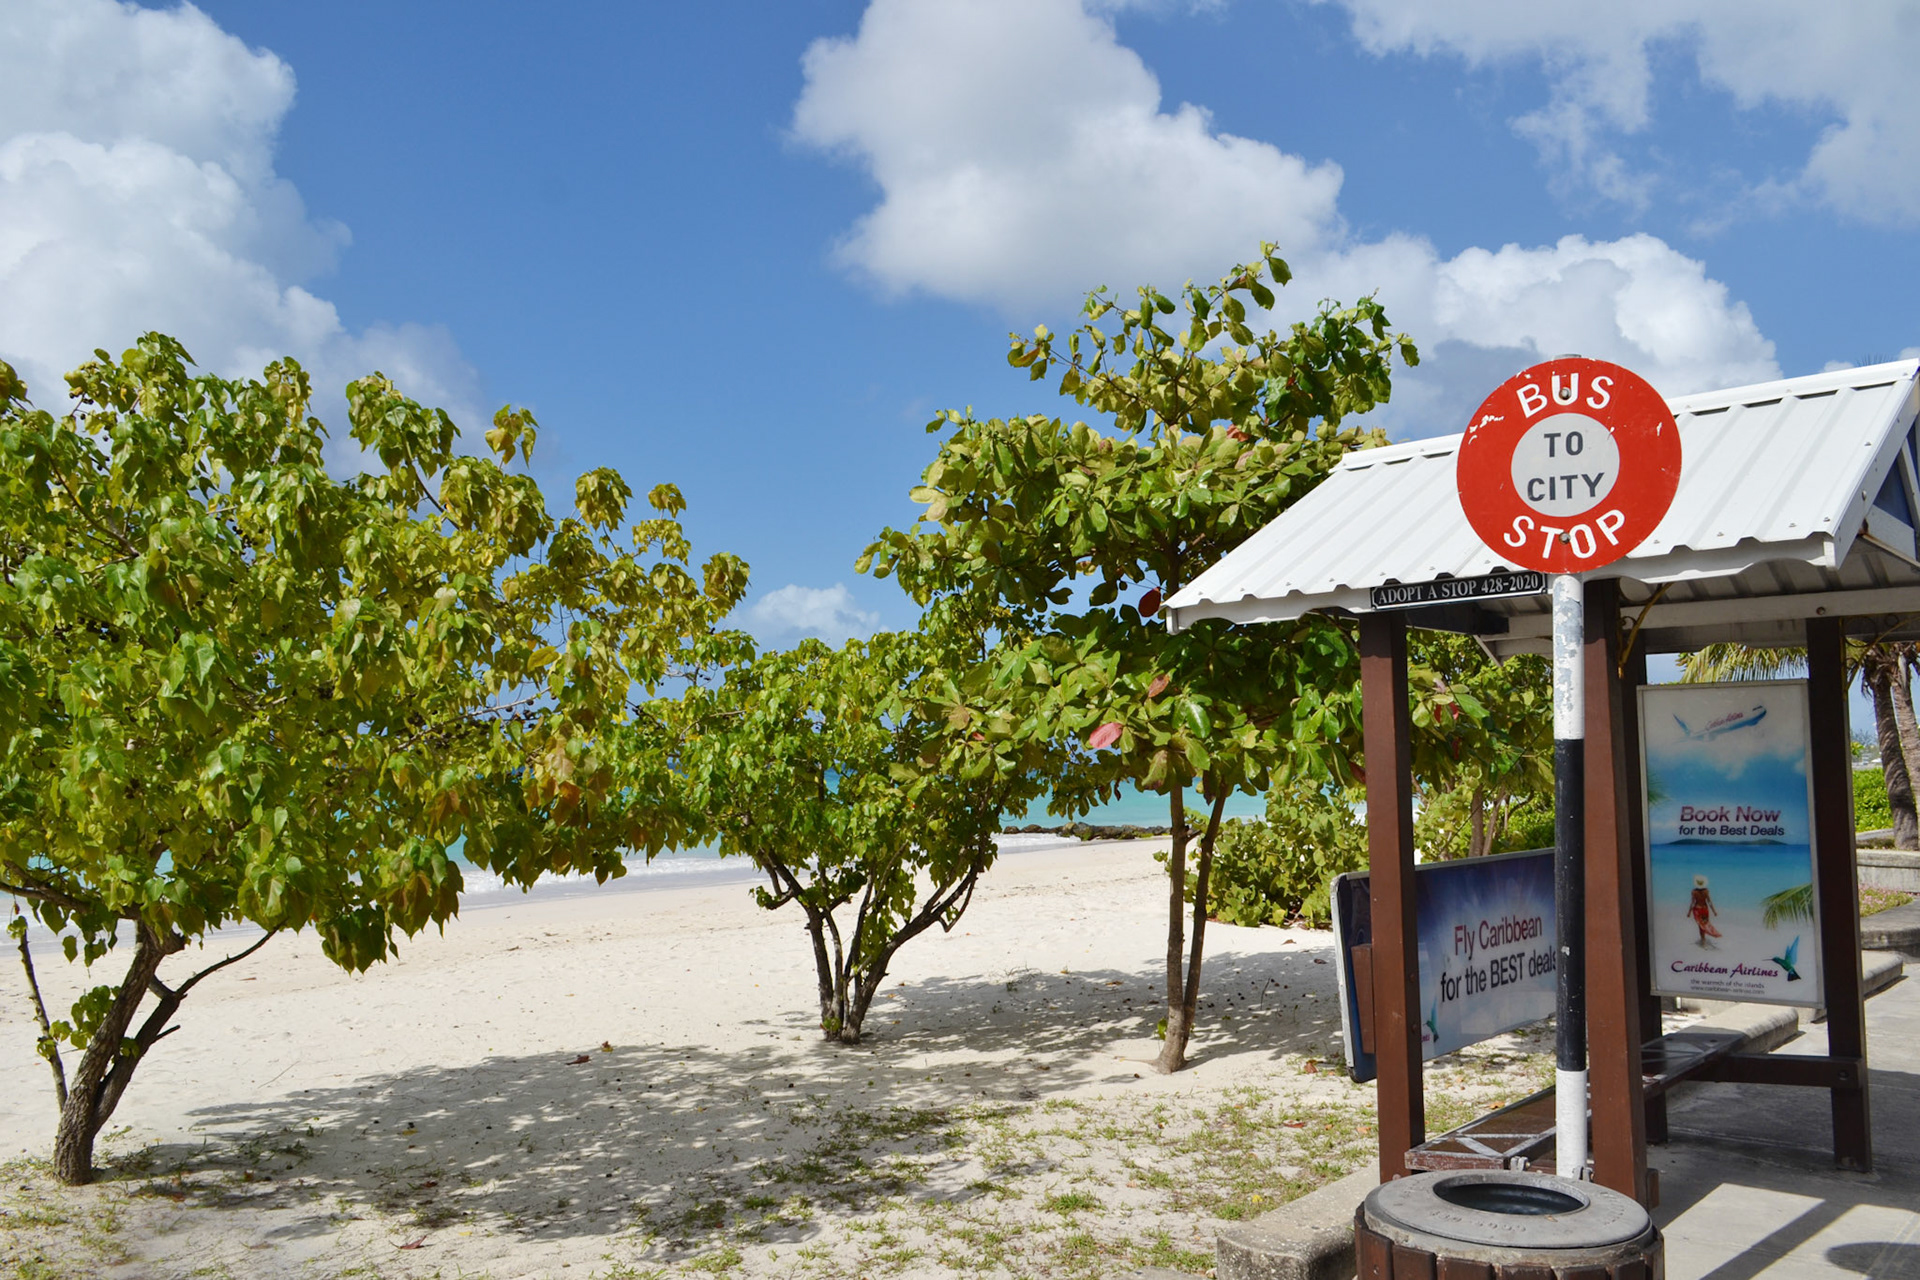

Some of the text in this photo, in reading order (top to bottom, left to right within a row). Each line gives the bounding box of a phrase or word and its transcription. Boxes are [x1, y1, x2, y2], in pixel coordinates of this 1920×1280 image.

[1516, 372, 1614, 418] BUS
[1543, 431, 1584, 457] TO
[1527, 472, 1605, 501] CITY
[1503, 509, 1626, 559] STOP
[1378, 574, 1538, 604] ADOPT A STOP 428-2020
[1680, 806, 1781, 822] Book Now
[1679, 825, 1785, 836] for the Best Deals
[1454, 915, 1542, 960] Fly Caribbean
[1440, 971, 1461, 1002] for
[1465, 966, 1487, 996] the
[1490, 952, 1526, 989] BEST
[1670, 960, 1779, 978] Caribbean Airlines
